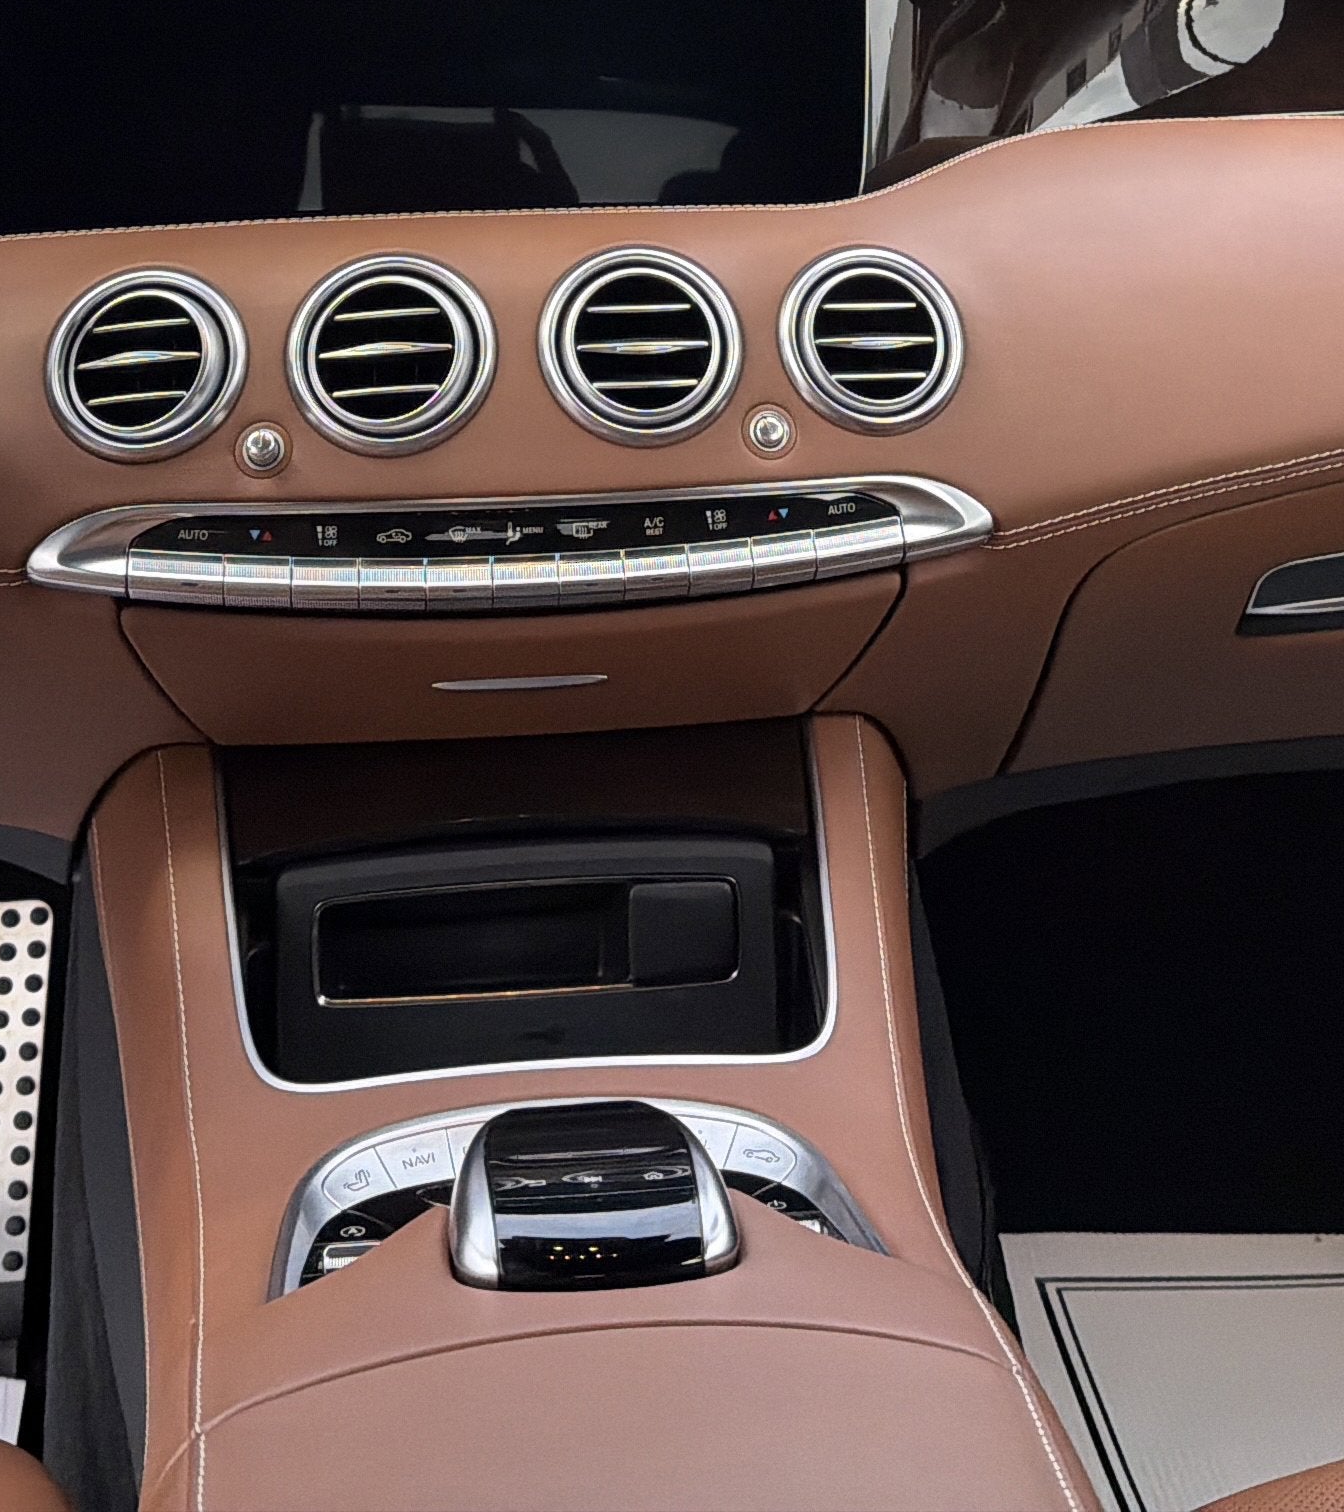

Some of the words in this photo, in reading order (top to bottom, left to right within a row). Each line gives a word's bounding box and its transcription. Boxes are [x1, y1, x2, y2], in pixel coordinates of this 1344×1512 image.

[826, 502, 857, 516] AUTO
[644, 515, 665, 528] A/C
[713, 522, 728, 531] OFF
[177, 528, 209, 541] AUTO
[465, 526, 482, 534] MAX
[522, 526, 545, 535] MENU
[323, 538, 338, 547] OFF
[401, 1151, 437, 1171] NAVI
